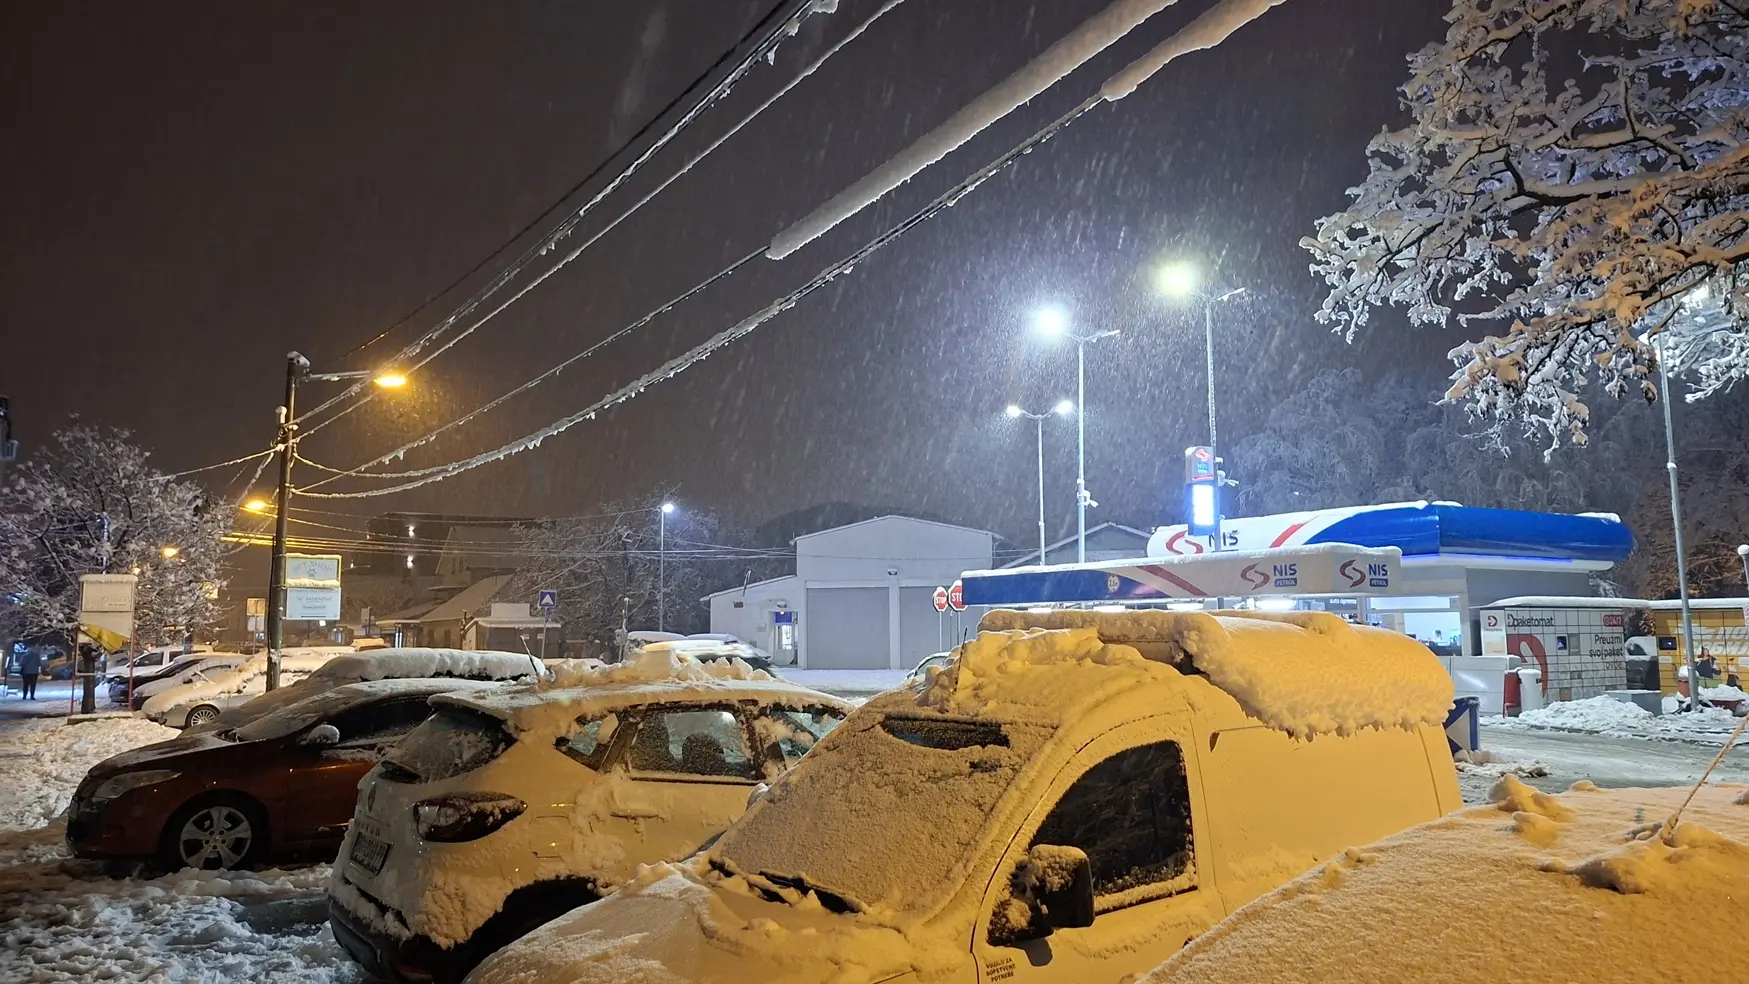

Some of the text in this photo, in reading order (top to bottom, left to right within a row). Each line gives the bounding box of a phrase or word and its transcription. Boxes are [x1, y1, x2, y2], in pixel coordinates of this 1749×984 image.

[1273, 563, 1297, 577] NIS
[1368, 563, 1388, 577] NIS
[1275, 578, 1297, 587] PETROL
[1370, 579, 1388, 587] PETROL
[1594, 634, 1623, 645] Preuzmi
[1604, 647, 1624, 660] paket
